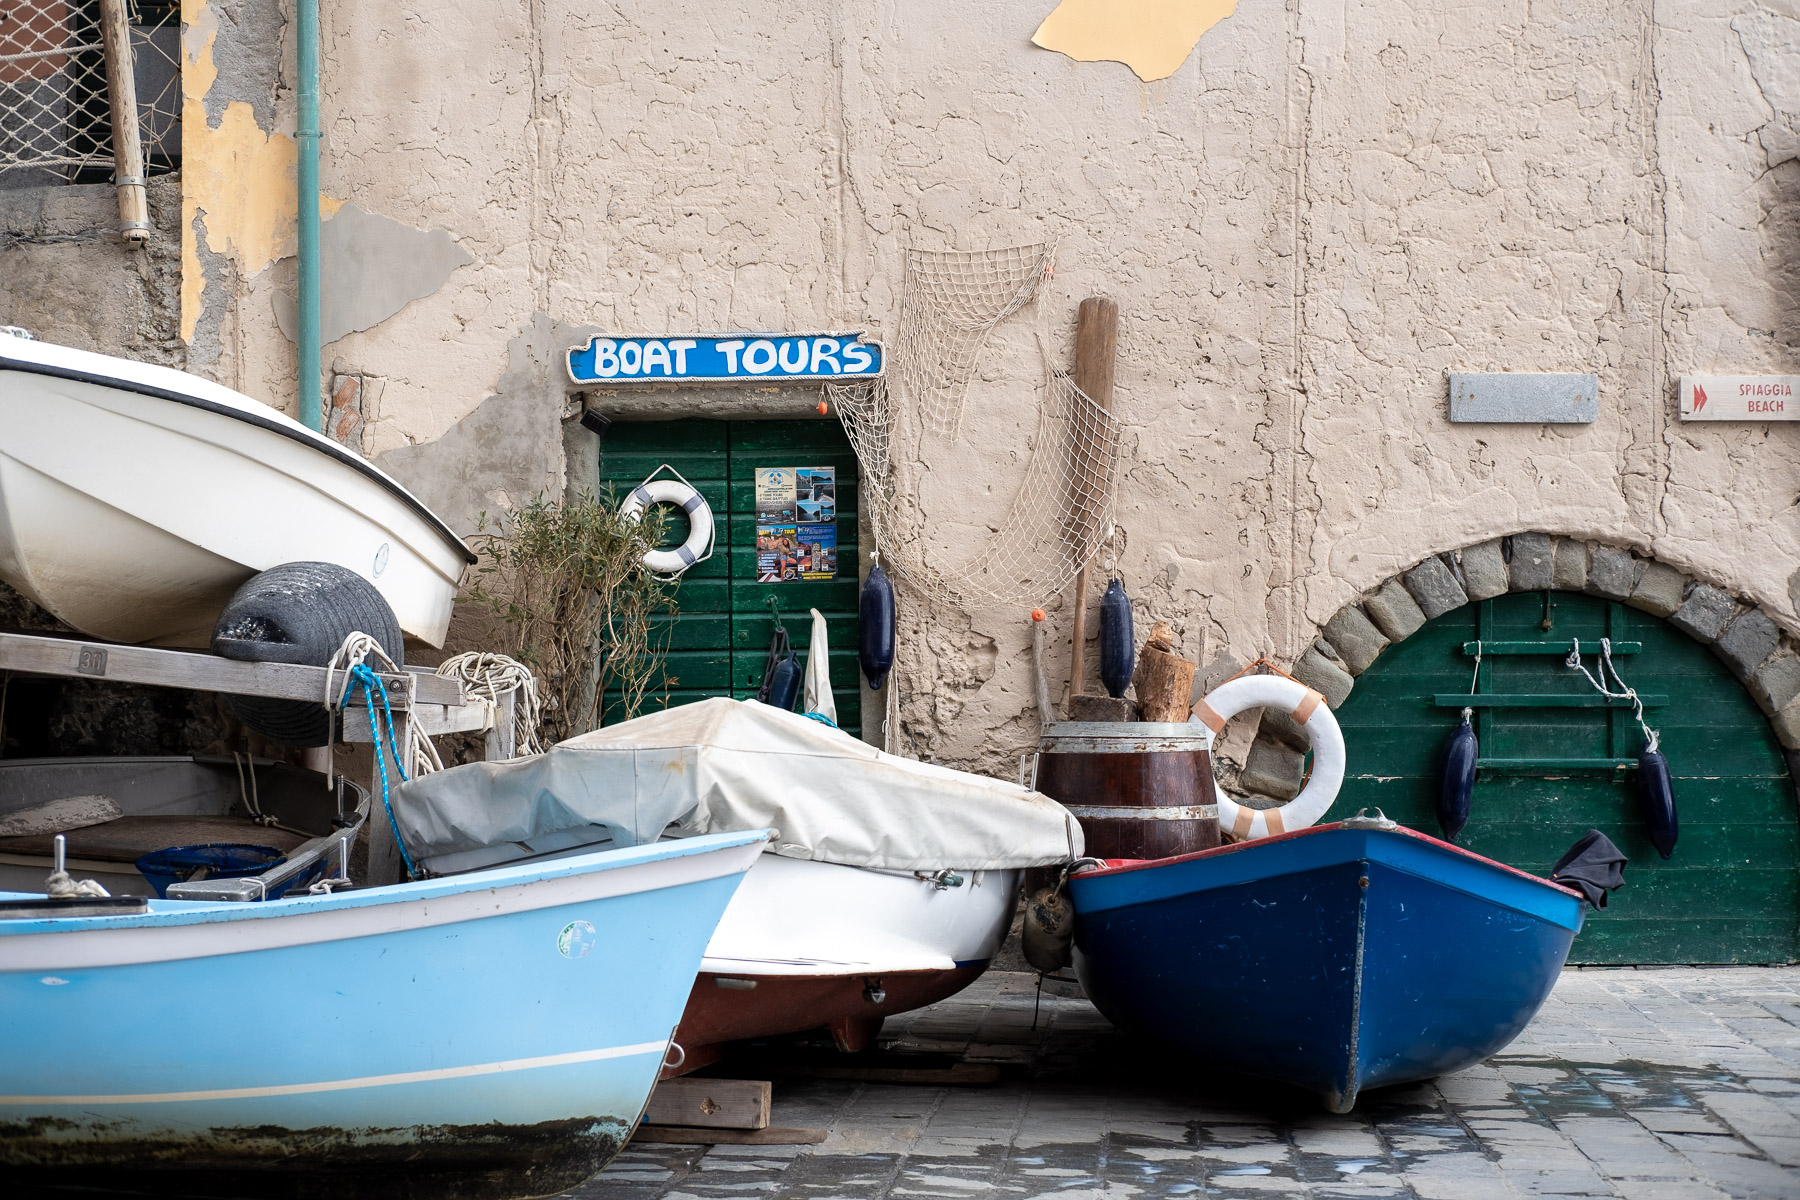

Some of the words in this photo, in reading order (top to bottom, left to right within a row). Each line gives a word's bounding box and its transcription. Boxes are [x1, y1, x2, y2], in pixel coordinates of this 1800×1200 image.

[594, 338, 697, 378] BOAT
[715, 338, 873, 375] TOURS
[1739, 384, 1792, 396] SPIAGGIA
[1748, 400, 1784, 412] BEACH
